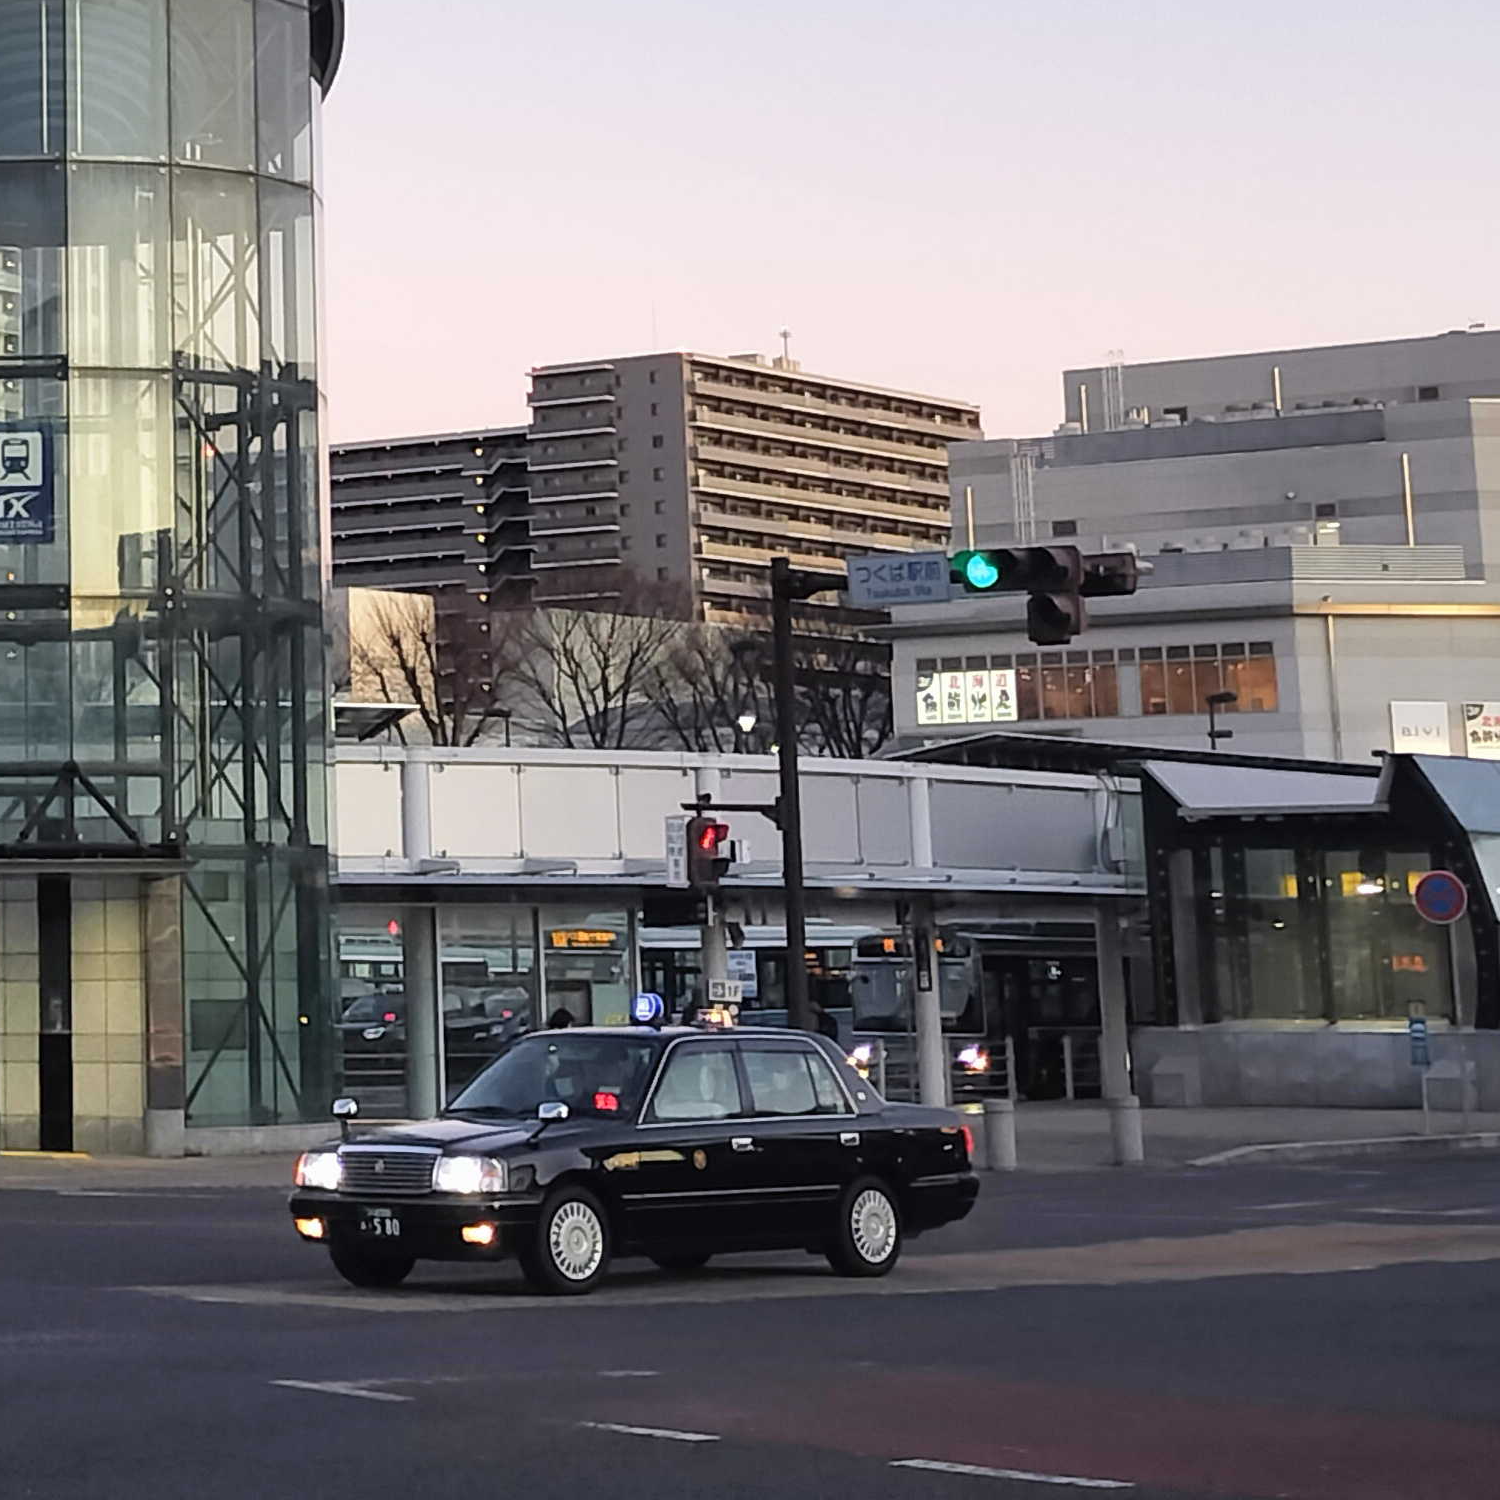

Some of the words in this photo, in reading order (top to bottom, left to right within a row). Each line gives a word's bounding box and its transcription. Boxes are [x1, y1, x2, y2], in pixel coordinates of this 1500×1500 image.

[856, 561, 940, 583] つくば駅前
